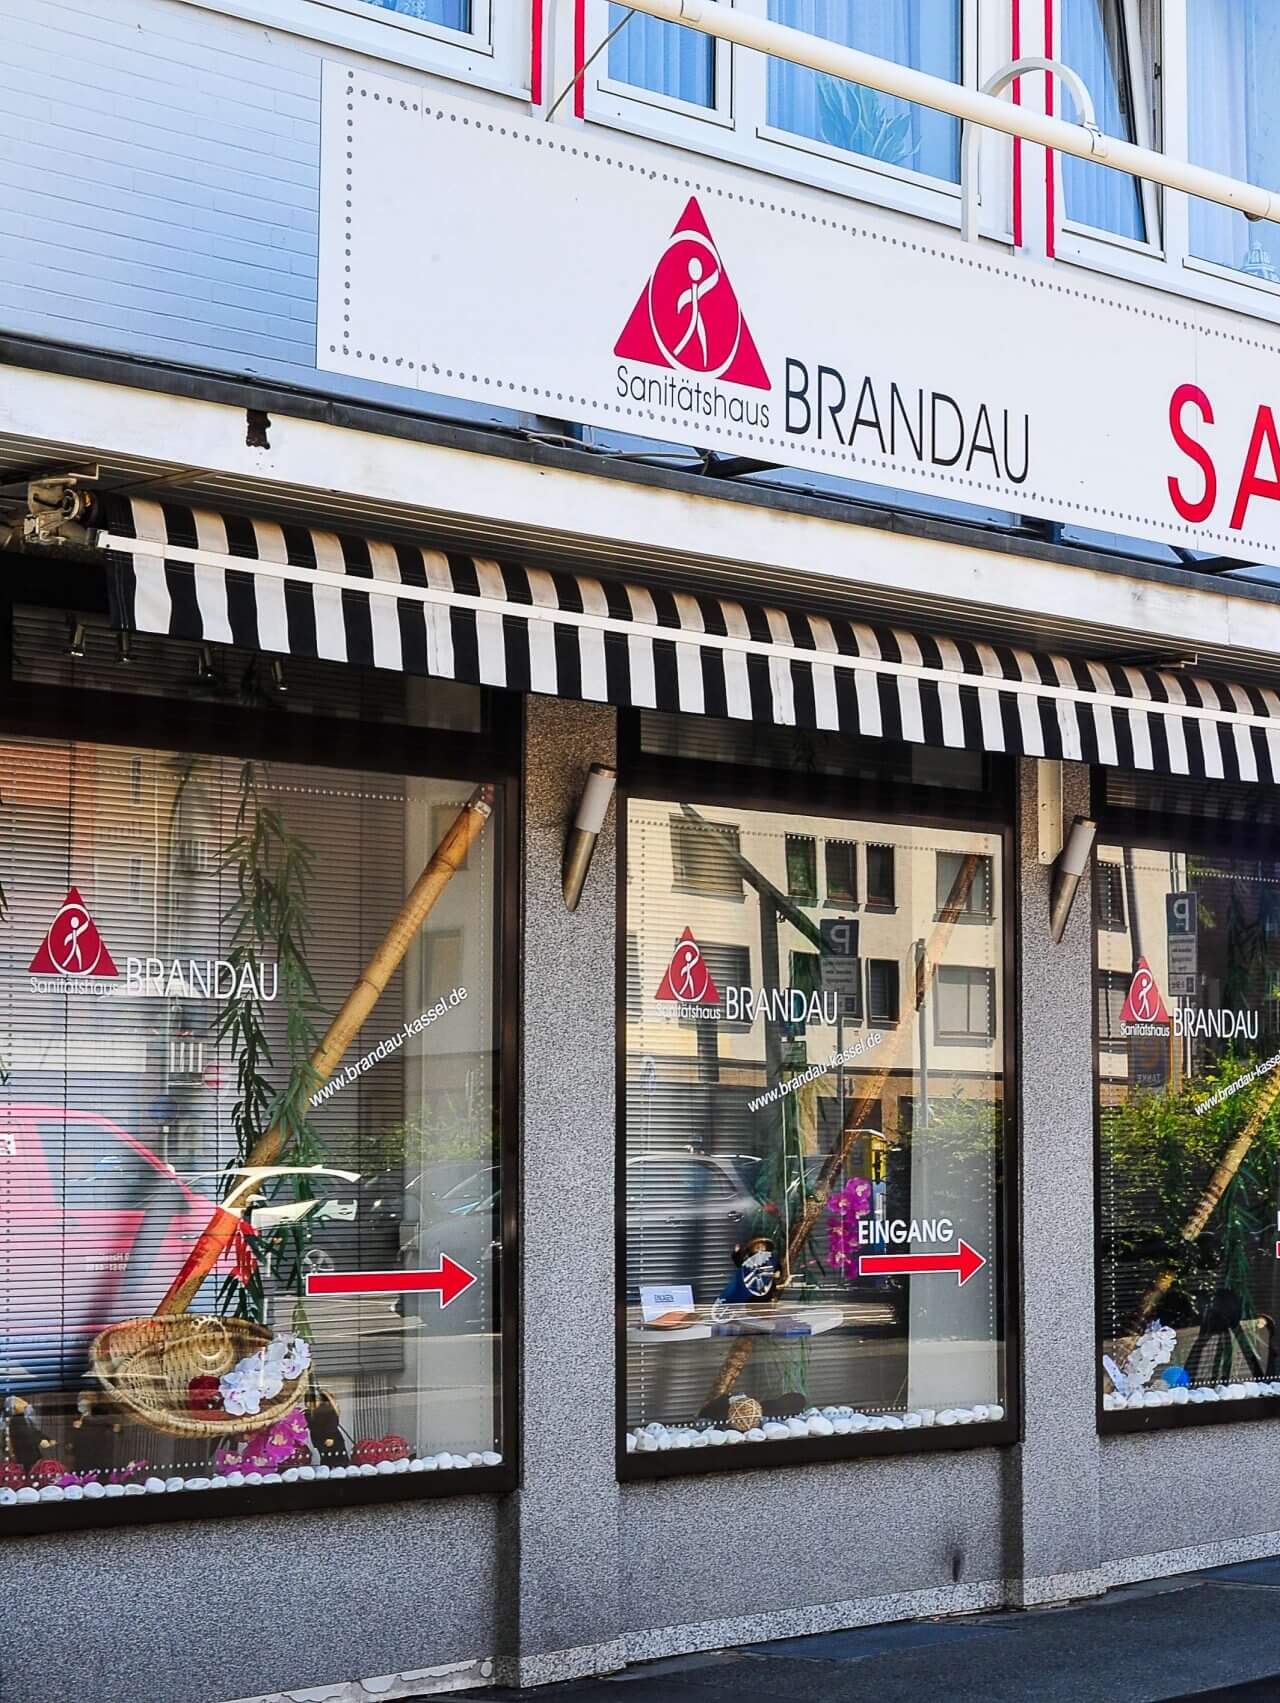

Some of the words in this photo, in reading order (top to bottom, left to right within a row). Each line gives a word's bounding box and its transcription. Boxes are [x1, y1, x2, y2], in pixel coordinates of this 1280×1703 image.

[615, 365, 770, 429] Sanitätshaus
[784, 356, 1030, 484] BRANDAU
[29, 976, 119, 996] Sanitätshaus
[126, 957, 278, 1000] BRANDAU
[655, 1002, 721, 1020] Sanitätshaus
[725, 986, 838, 1024] BRANDAU
[1173, 1007, 1259, 1040] BRANDAU
[308, 986, 468, 1107] www.brandau-kassel.de
[1119, 1023, 1170, 1037] Sanitätshaus
[747, 1032, 882, 1113] www.brandau-kassel.de
[858, 1218, 954, 1245] EINGANG
